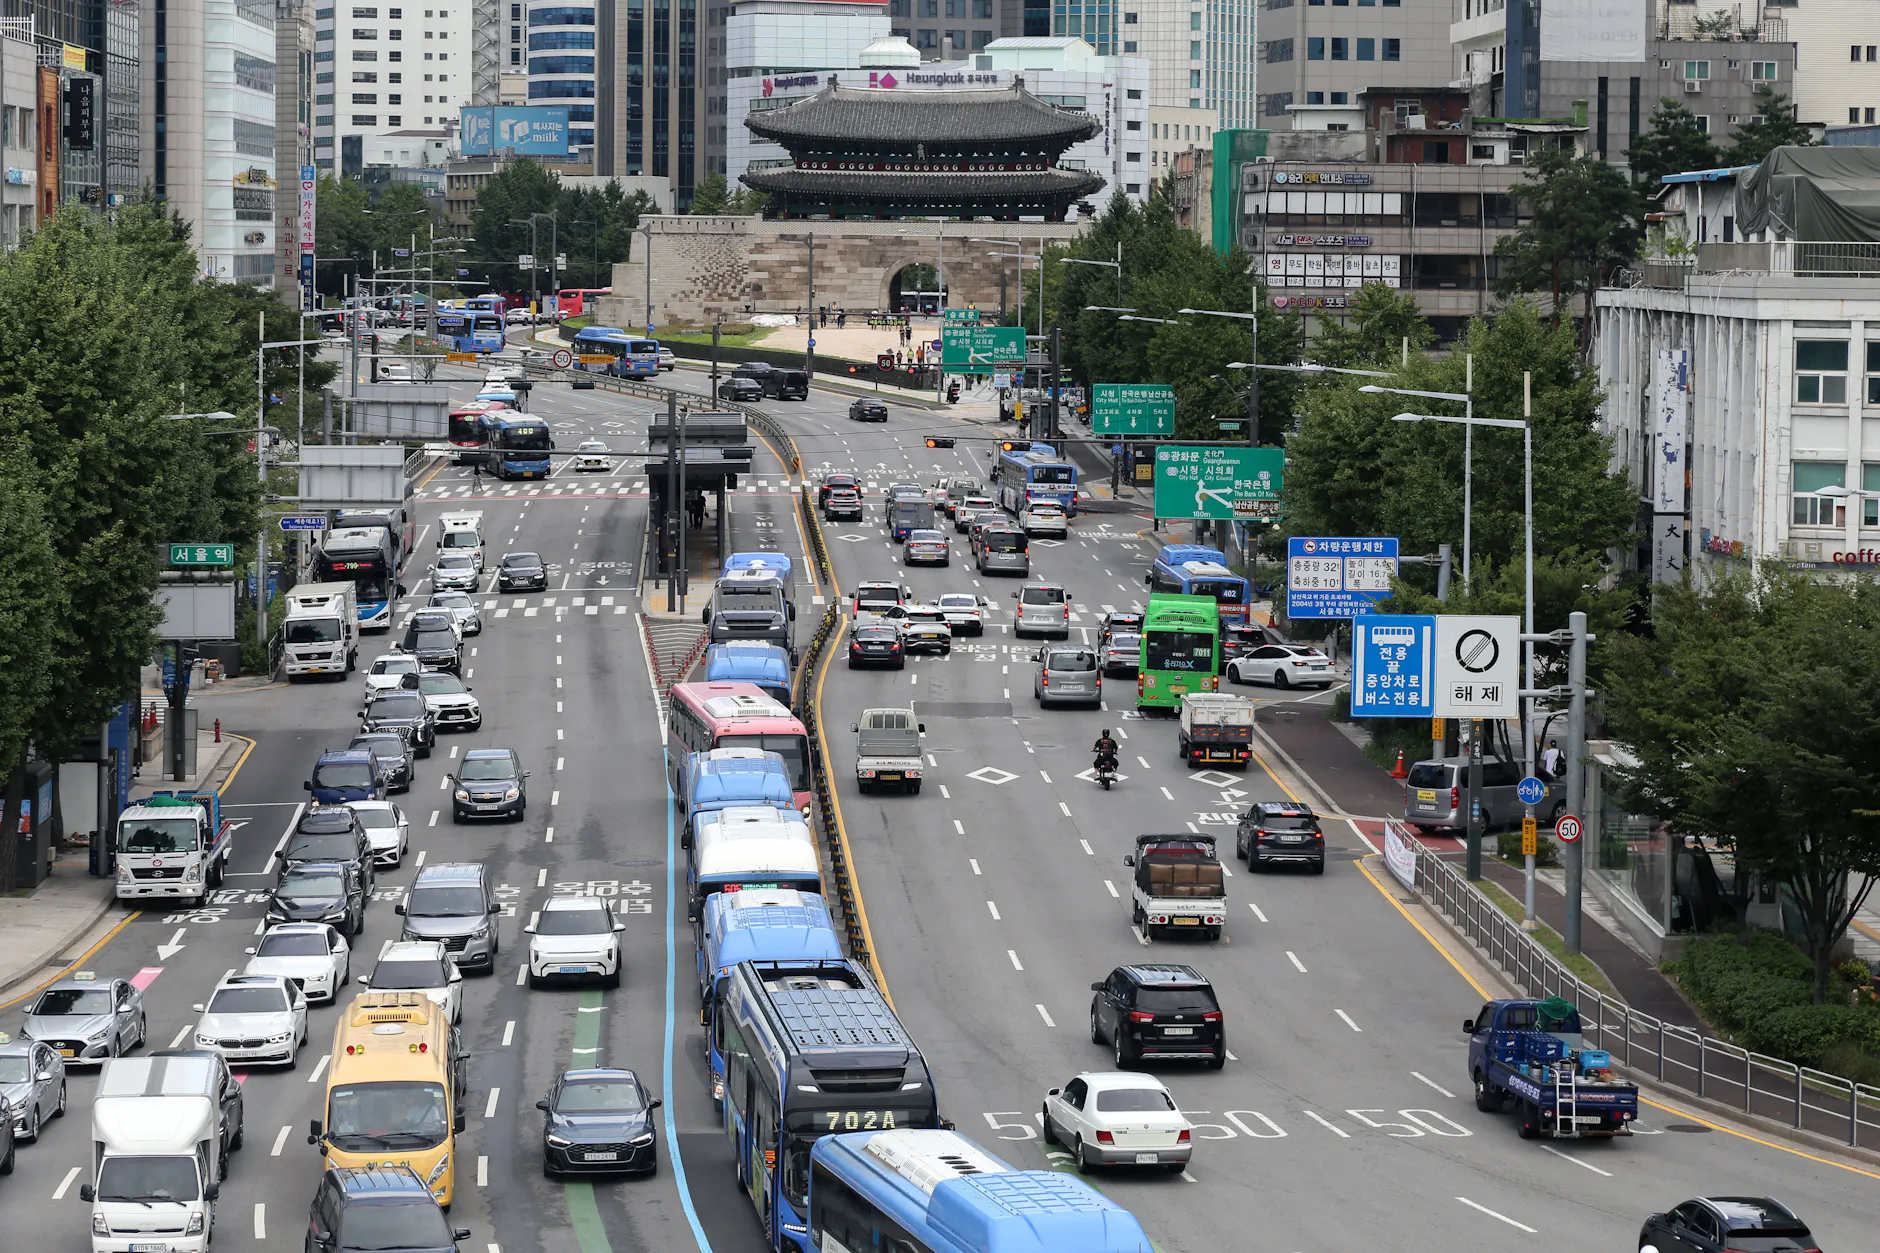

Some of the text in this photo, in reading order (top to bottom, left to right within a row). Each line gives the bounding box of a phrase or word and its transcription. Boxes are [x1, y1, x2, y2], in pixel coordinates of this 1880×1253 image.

[907, 72, 998, 86] Heungkuk 흥국생명
[532, 122, 563, 131] 복사지는
[533, 132, 559, 142] miilk
[302, 200, 313, 241] 가슴제작
[284, 217, 295, 275] 치과재료
[1316, 236, 1344, 245] 스포츠
[1272, 259, 1281, 270] 영
[1288, 260, 1303, 268] 무도
[1308, 260, 1322, 270] 학원
[1384, 261, 1398, 271] 탱고
[556, 354, 569, 364] 50
[1122, 390, 1148, 398] 한국은행
[1171, 450, 1225, 462] 광화문 光化門
[1180, 466, 1234, 475] 시청 시의회
[1234, 480, 1271, 490] 한국은행
[1234, 501, 1259, 510] 남산공원
[1318, 541, 1384, 553] 차량운행제한
[1779, 542, 1823, 563] 캡틴
[176, 548, 227, 562] 서울역
[1294, 560, 1320, 572] 총중량
[1348, 560, 1365, 569] 높이
[1348, 570, 1365, 579] 길이
[1294, 576, 1320, 588] 축하중
[1353, 580, 1361, 588] 폭
[1223, 590, 1237, 598] 402
[1319, 608, 1367, 616] 서울특별시장
[1194, 648, 1211, 657] 7011
[1379, 647, 1408, 661] 전용
[1386, 660, 1401, 674] 끝
[1366, 674, 1421, 689] 중앙차로
[1365, 691, 1420, 706] 버스전용
[1455, 685, 1499, 702] 해제
[1562, 823, 1577, 836] 50
[826, 1111, 896, 1130] 702A
[1346, 1109, 1473, 1139] 50
